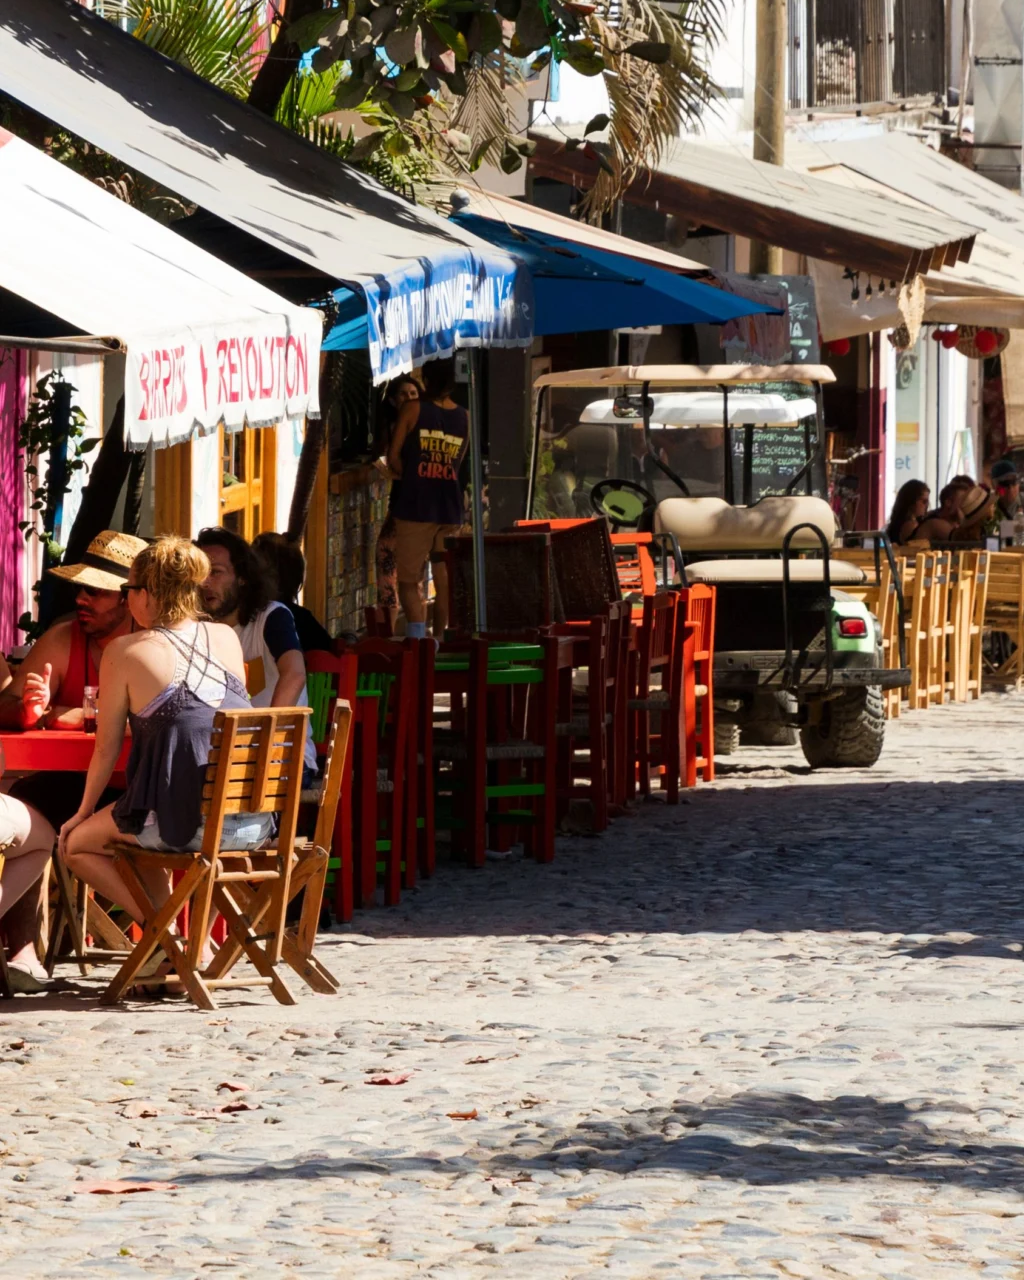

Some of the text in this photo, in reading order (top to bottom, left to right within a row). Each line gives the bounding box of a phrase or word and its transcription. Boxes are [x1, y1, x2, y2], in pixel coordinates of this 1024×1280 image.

[411, 277, 457, 339] TRADICION
[216, 332, 309, 405] REVOLUTON
[420, 437, 460, 459] WELCME
[418, 461, 457, 481] CIRC
